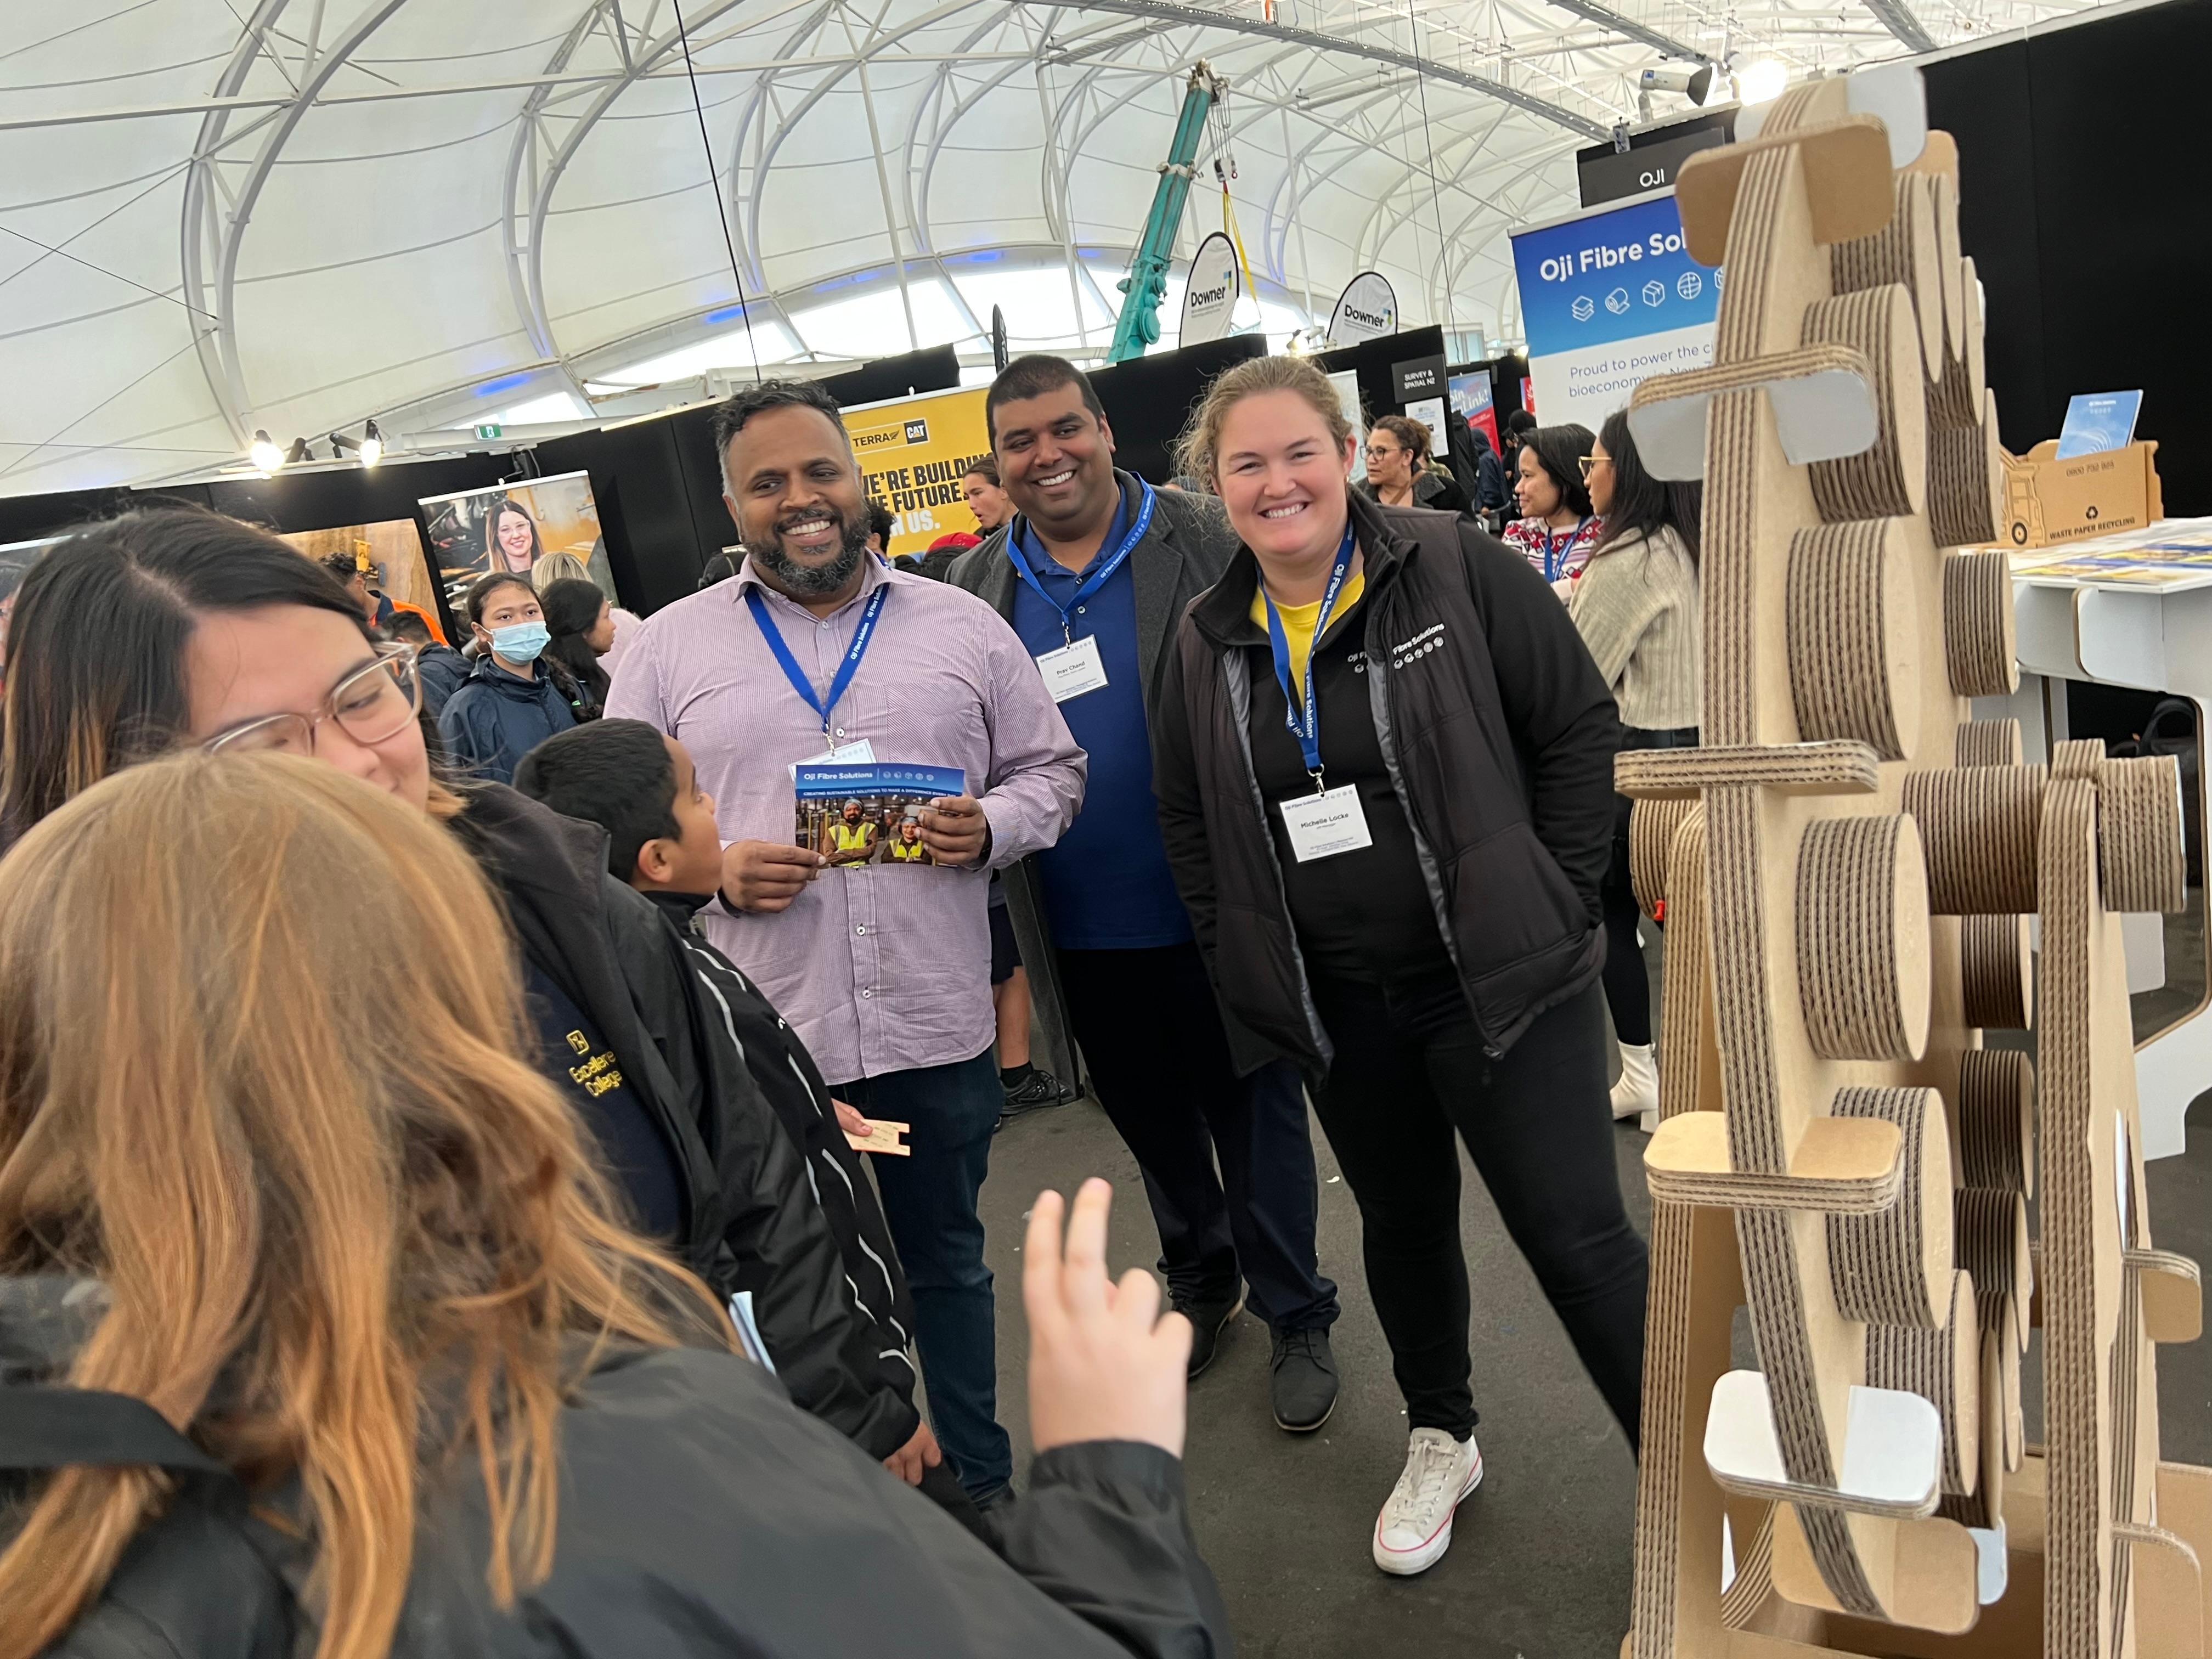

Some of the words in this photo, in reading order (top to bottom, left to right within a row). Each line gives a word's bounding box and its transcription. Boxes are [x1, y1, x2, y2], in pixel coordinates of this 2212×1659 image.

[1640, 168, 1664, 187] OJI
[1540, 254, 1573, 282] Oji
[1579, 243, 1643, 273] Fibre
[1649, 227, 1687, 256] Sol
[1191, 286, 1226, 307] Downer
[1345, 304, 1384, 328] Downer
[1570, 360, 1609, 379] Proud
[1612, 359, 1626, 370] to
[1630, 351, 1673, 370] power
[1677, 346, 1699, 359] the
[1404, 370, 1426, 381] SURVEY
[1404, 379, 1426, 390] SPATIAL
[1426, 377, 1436, 385] NZ
[853, 433, 890, 447] TERRA
[906, 425, 924, 439] CAT
[906, 509, 941, 534] US.
[2050, 528, 2072, 540] WASTE
[2074, 524, 2096, 535] PAPER
[2098, 516, 2135, 531] RECYCLING
[1334, 564, 1345, 576] Oji
[1327, 577, 1340, 599] Fibre
[1392, 640, 1413, 656] Fibre
[1412, 623, 1445, 645] Solutions
[1069, 661, 1085, 670] Chand
[1347, 652, 1358, 663] Oji
[1292, 726, 1304, 738] Oji
[804, 772, 816, 781] Oji
[1301, 818, 1328, 829] Michelle
[1329, 813, 1349, 822] Locke
[569, 1051, 616, 1084] Excellere
[585, 1070, 623, 1098] College
